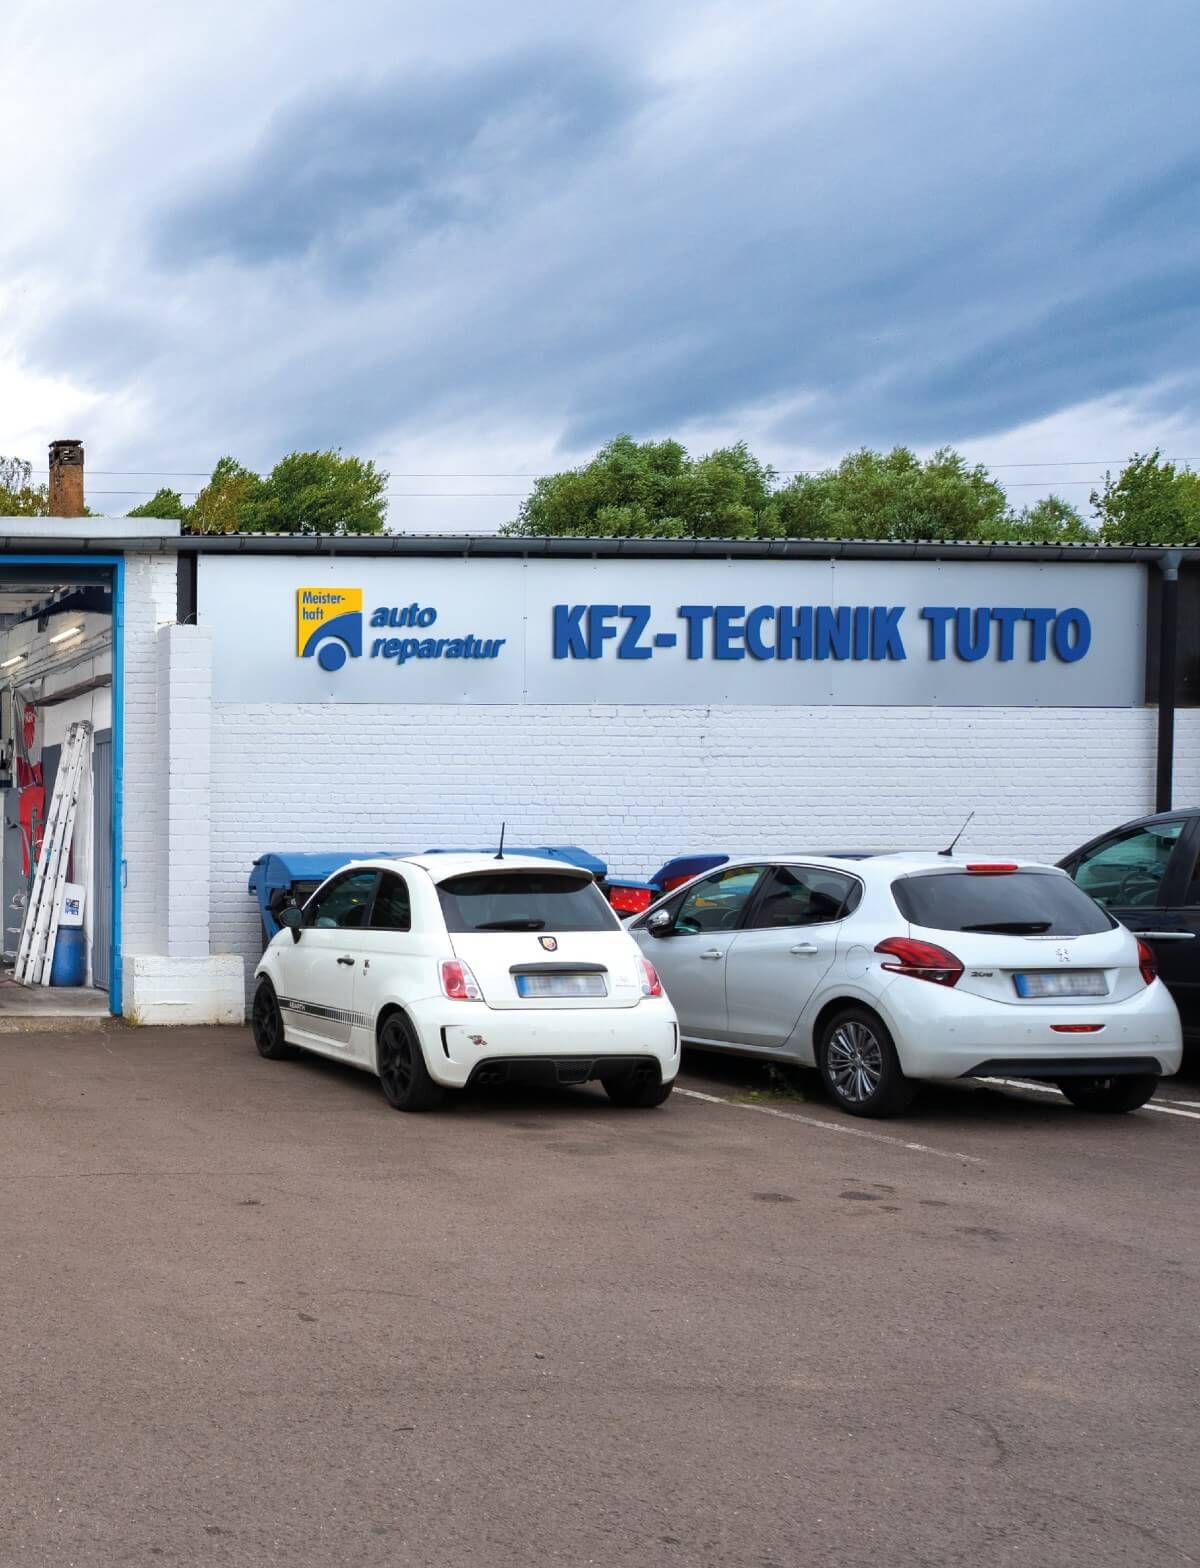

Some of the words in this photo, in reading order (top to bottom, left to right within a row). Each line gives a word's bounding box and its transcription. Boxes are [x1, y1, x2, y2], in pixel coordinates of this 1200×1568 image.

[302, 591, 346, 605] Meister-
[302, 607, 324, 621] haft
[370, 602, 437, 627] auto
[551, 604, 907, 661] KFZ-TECHNIK
[921, 606, 1092, 664] TUTTO
[370, 634, 506, 665] reparatur
